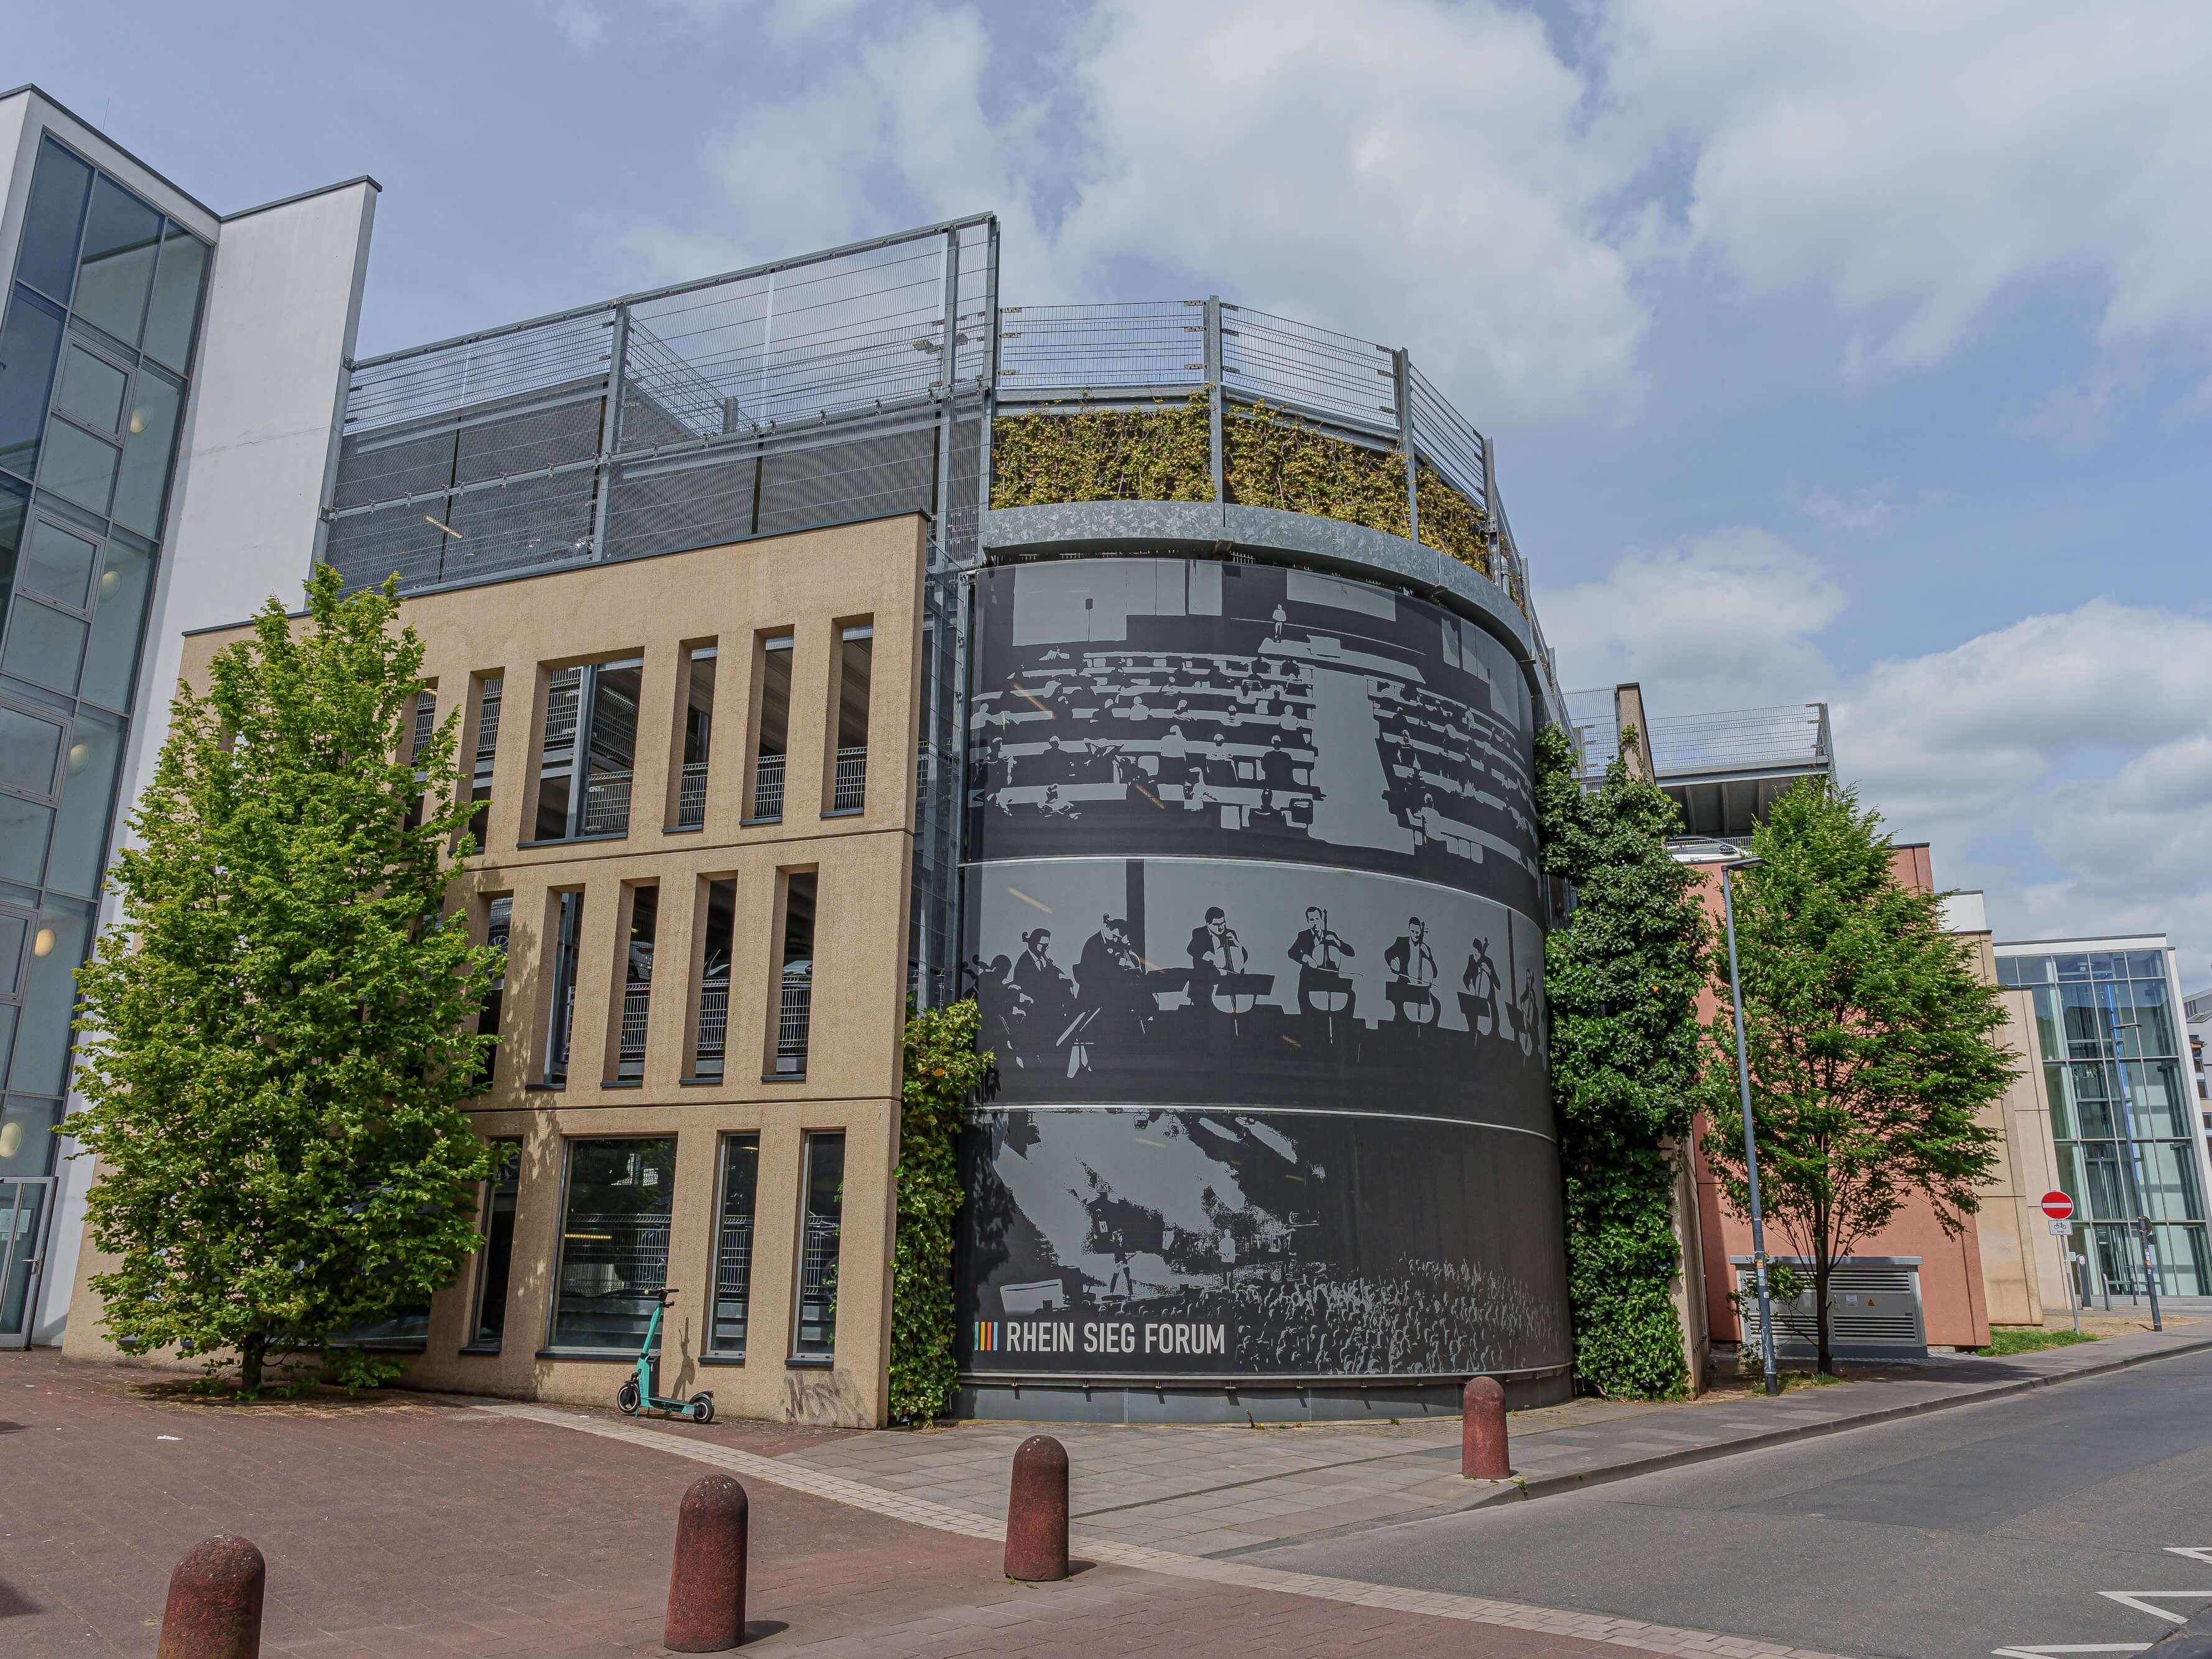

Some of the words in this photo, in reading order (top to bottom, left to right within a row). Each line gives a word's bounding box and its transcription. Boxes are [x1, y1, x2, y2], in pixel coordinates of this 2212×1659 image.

[1006, 1322, 1074, 1352] RHEIN
[1084, 1322, 1135, 1353] SIEG
[1145, 1323, 1225, 1354] FORUM
